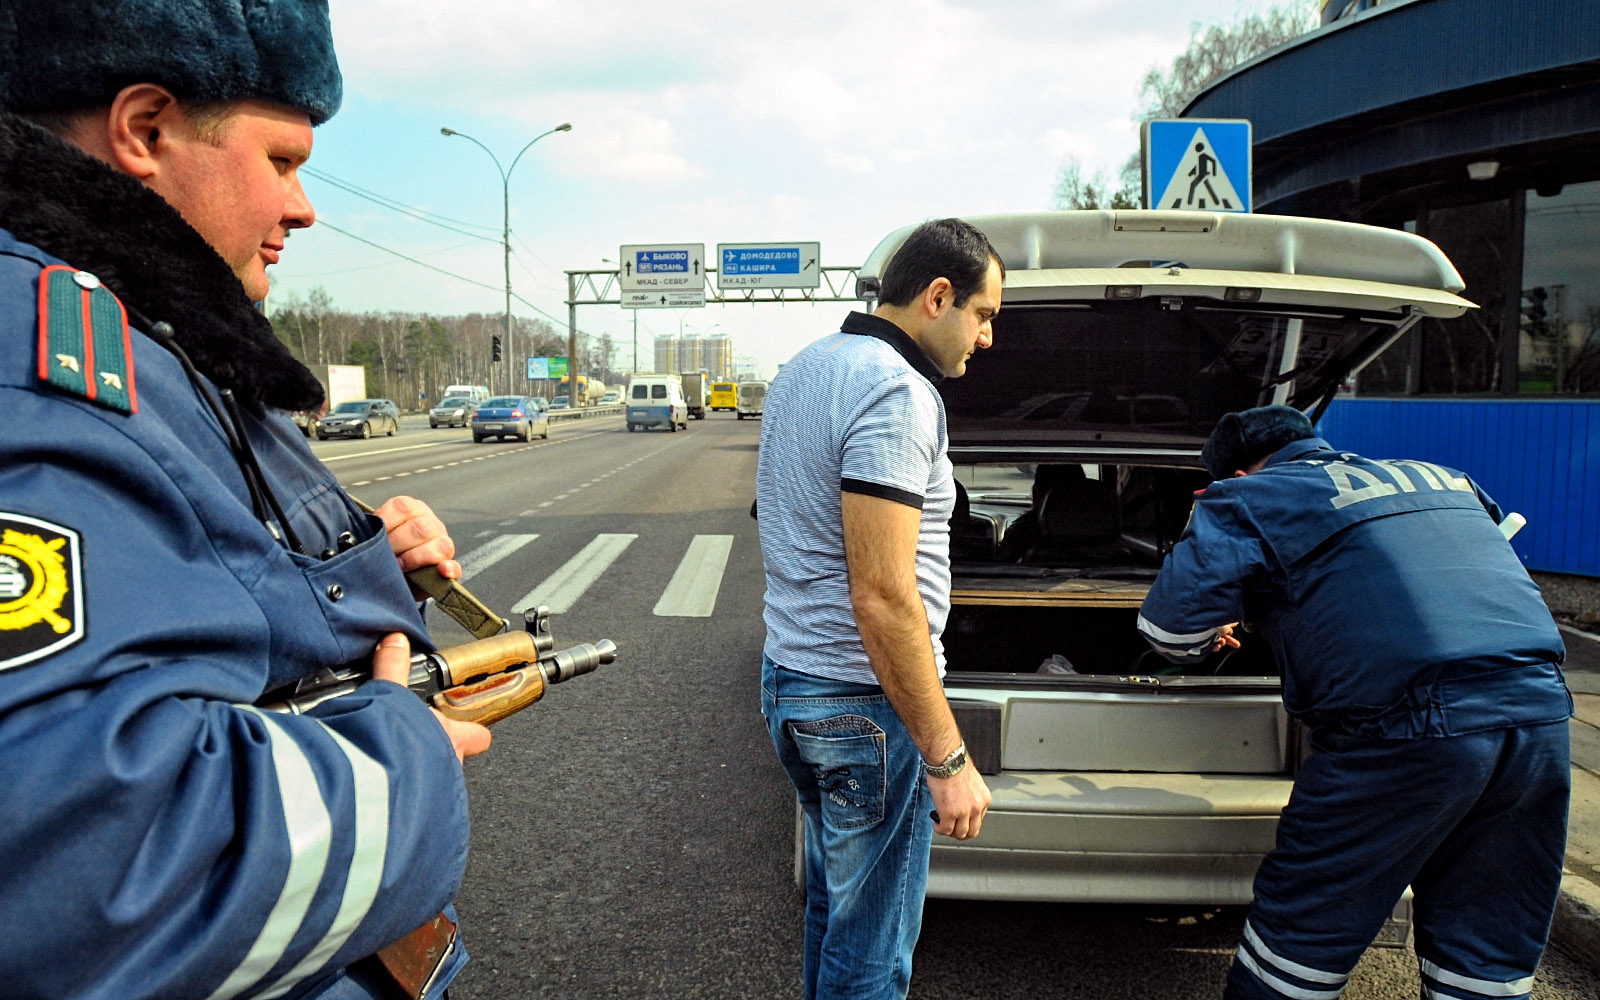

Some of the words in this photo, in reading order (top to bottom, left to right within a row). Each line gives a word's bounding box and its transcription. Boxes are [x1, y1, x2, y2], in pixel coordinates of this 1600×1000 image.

[653, 252, 686, 260] БЫКОВО
[740, 252, 798, 260] ДОМОДЕДОВО
[653, 263, 684, 271] РЯЗАНЬ
[740, 264, 776, 272] КАШИРА
[848, 779, 860, 791] GS
